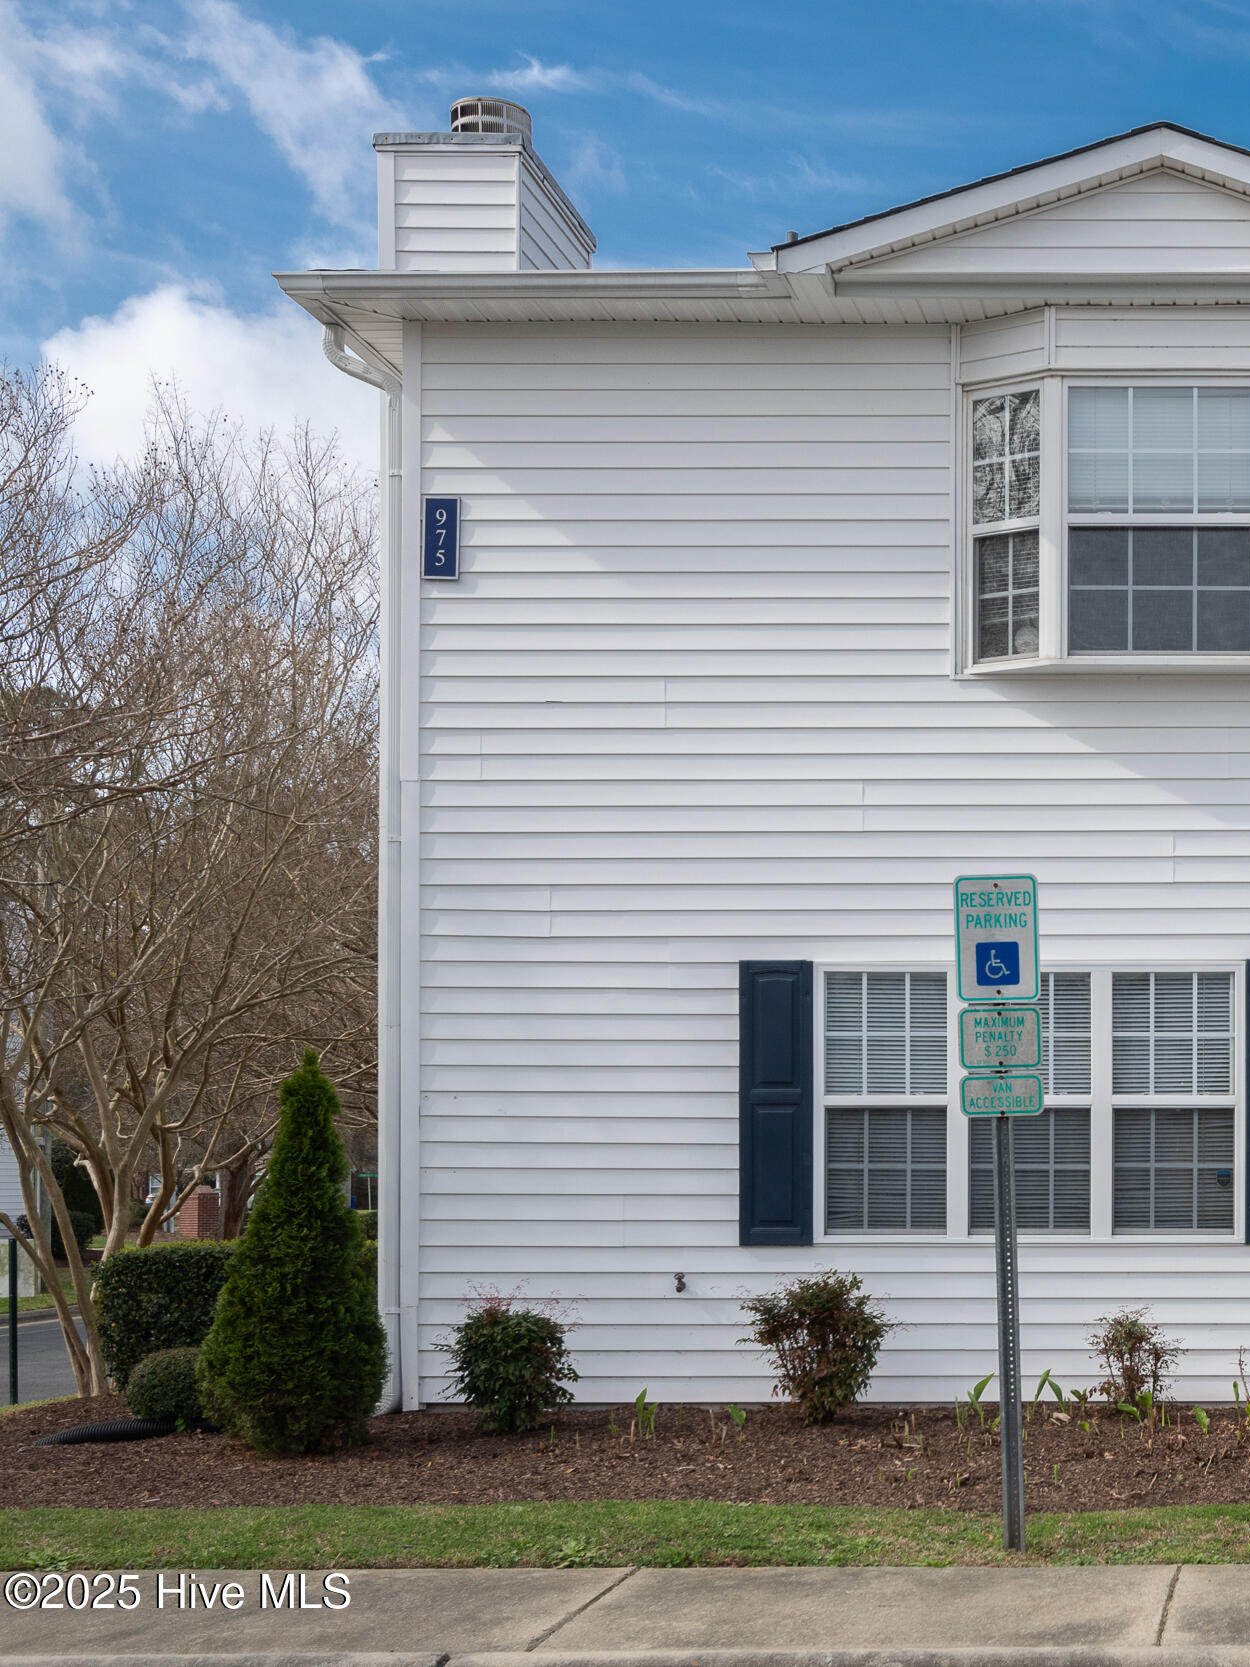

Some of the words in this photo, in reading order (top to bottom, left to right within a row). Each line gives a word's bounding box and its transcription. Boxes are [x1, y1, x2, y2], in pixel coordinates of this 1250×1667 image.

[435, 508, 447, 566] 975
[960, 891, 1032, 907] RESERVED
[966, 913, 1028, 929] PARKING
[974, 1016, 1025, 1028] MAXIMUM
[975, 1030, 1023, 1043] PENALTY
[992, 1082, 1013, 1094] VAN
[969, 1095, 1036, 1109] ACCESSIBLE
